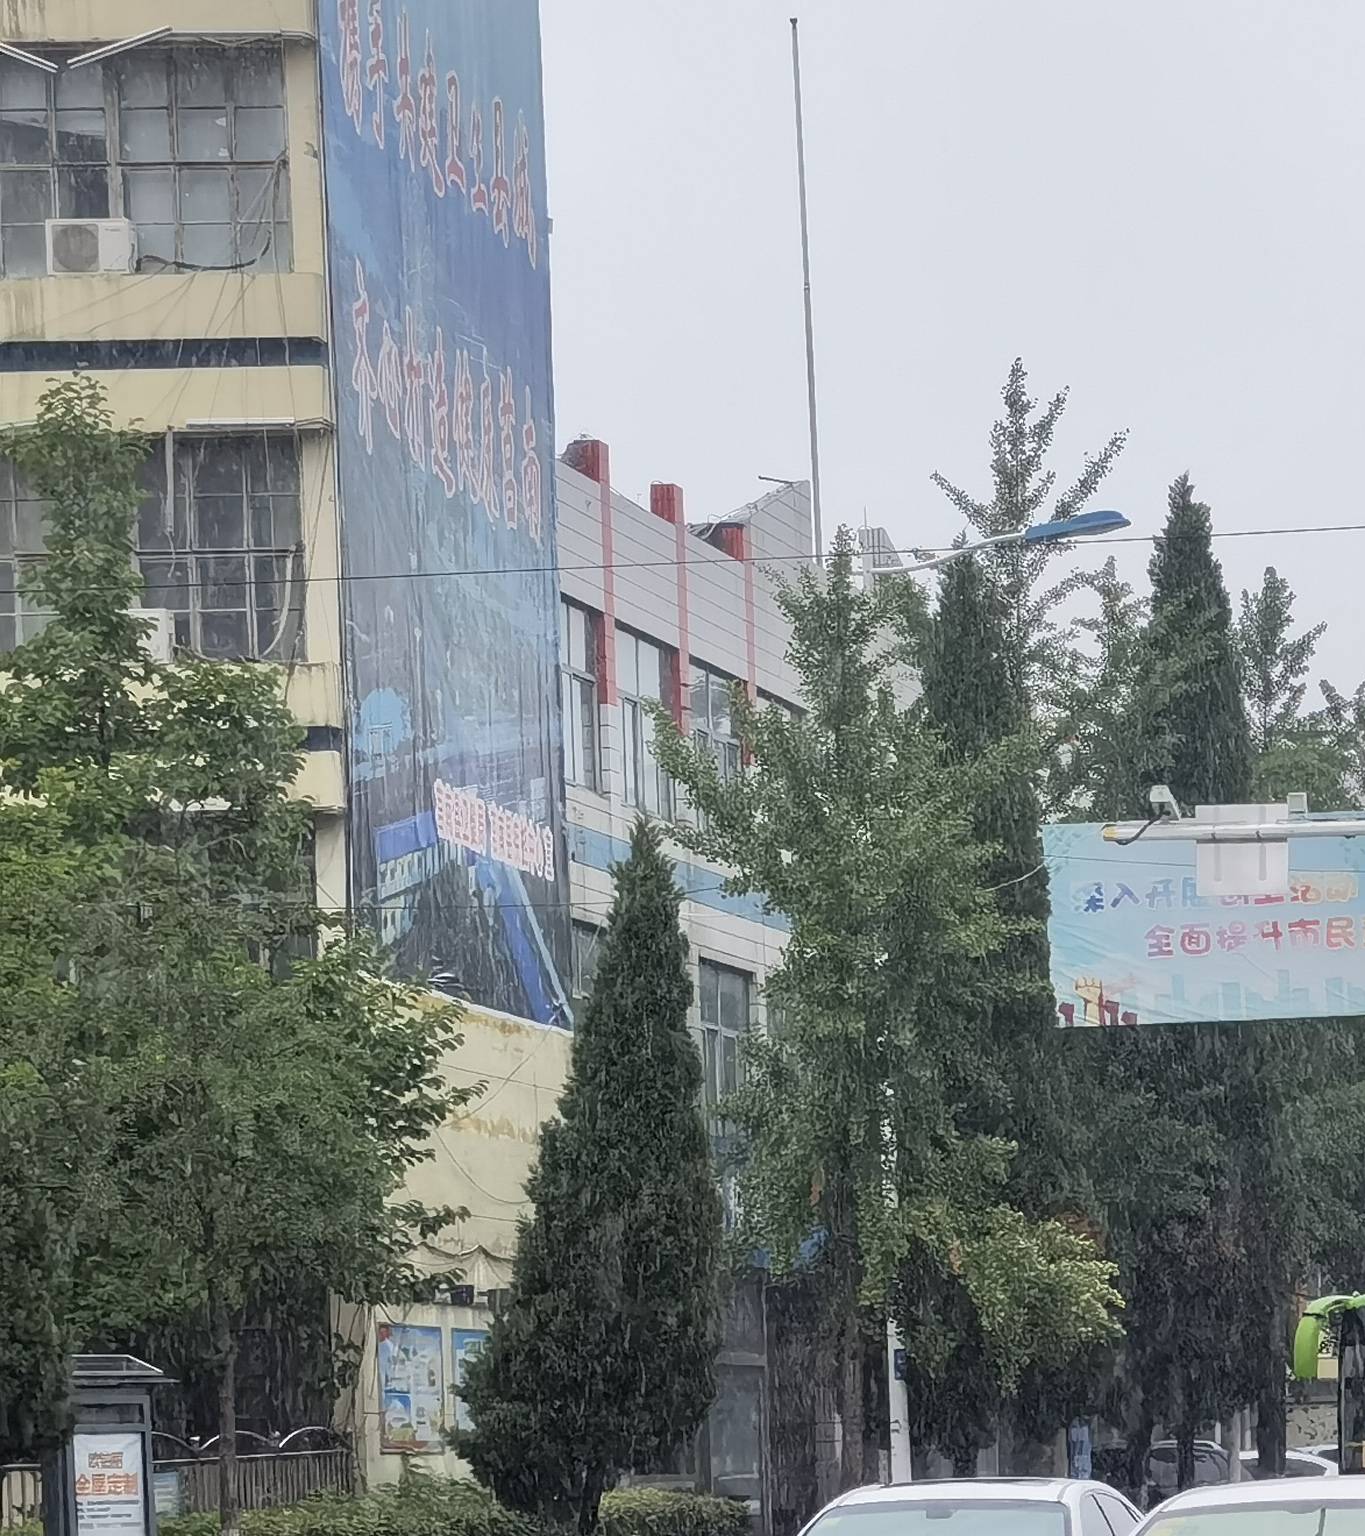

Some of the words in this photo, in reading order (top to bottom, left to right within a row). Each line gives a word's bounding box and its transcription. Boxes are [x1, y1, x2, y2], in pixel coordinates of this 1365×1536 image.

[1072, 873, 1356, 913] 深入开展活动
